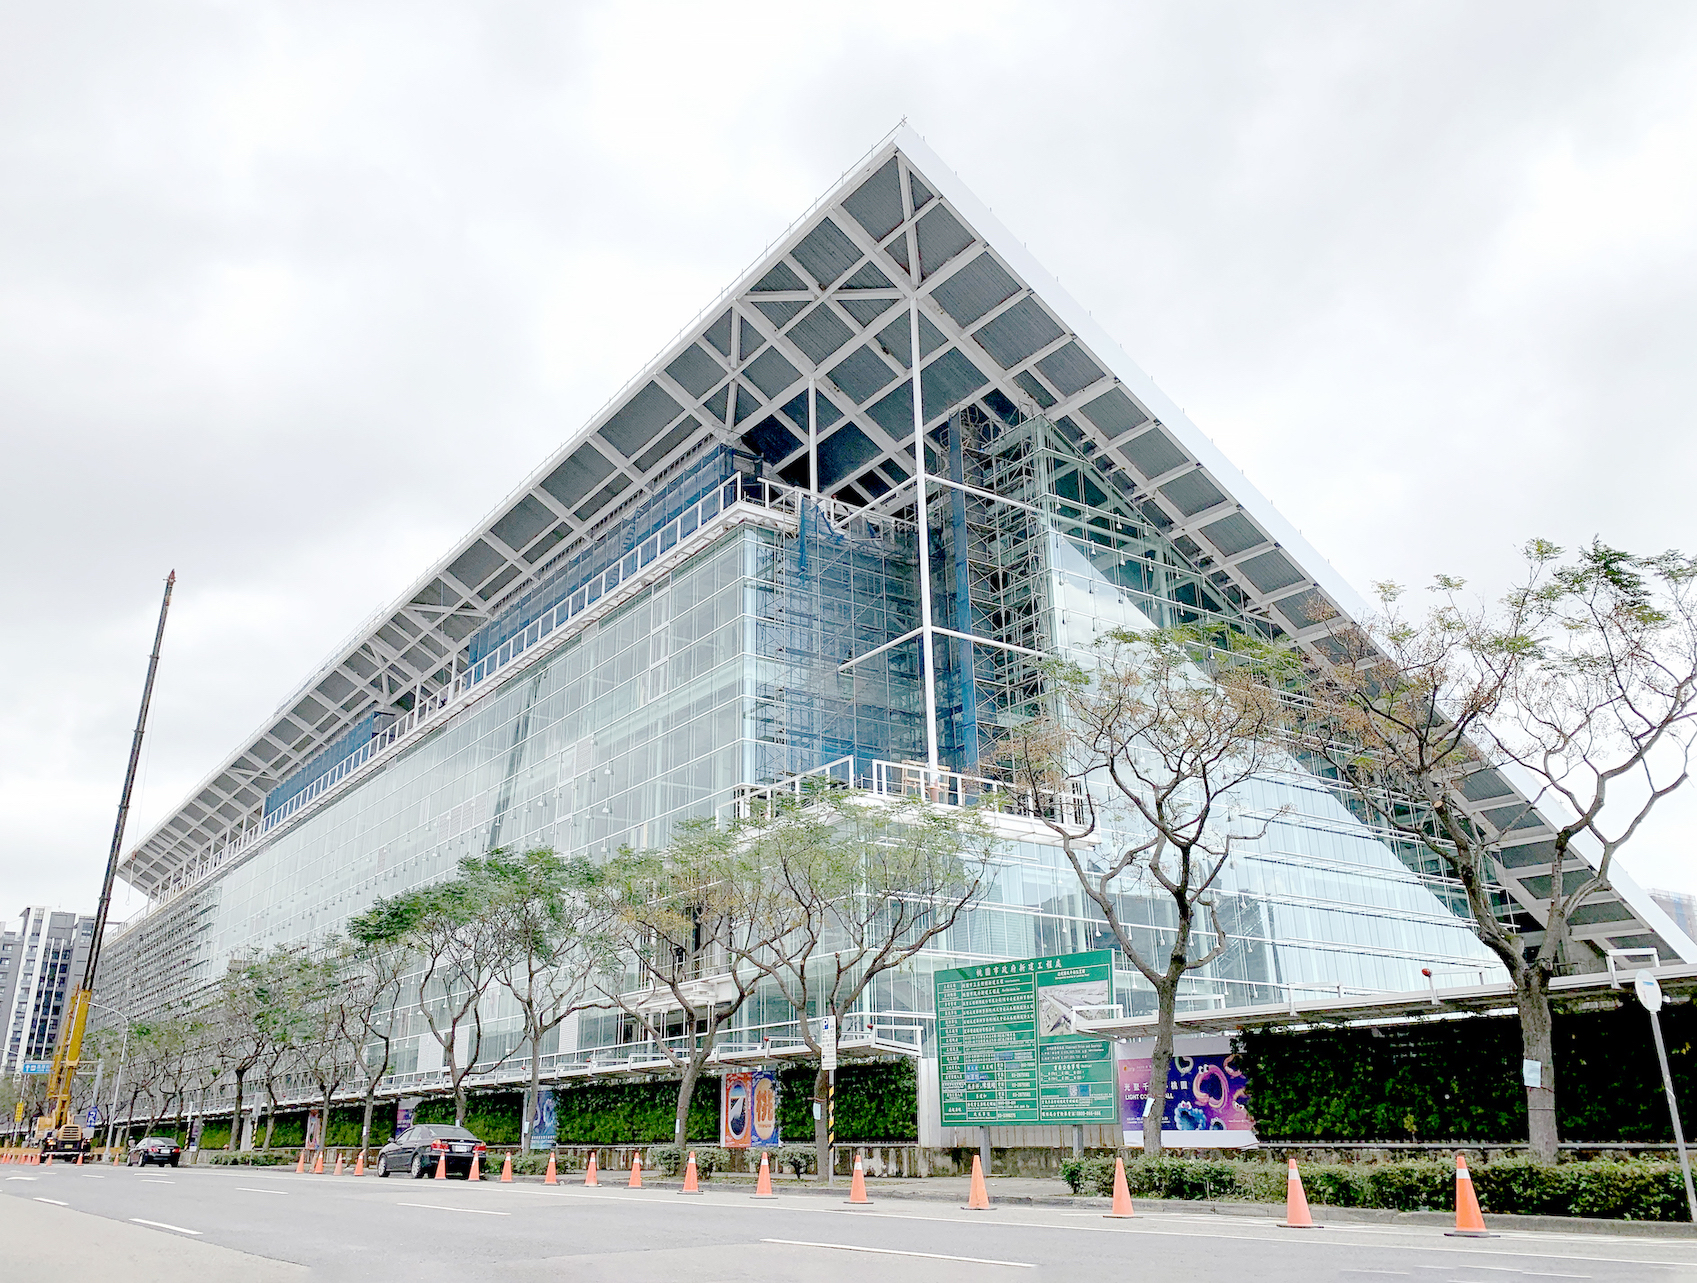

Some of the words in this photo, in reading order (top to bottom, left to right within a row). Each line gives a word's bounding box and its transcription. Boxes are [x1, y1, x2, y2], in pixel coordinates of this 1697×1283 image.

[976, 958, 1062, 977] 桃園市政府新建工程處
[1125, 1093, 1139, 1101] LIGHT
